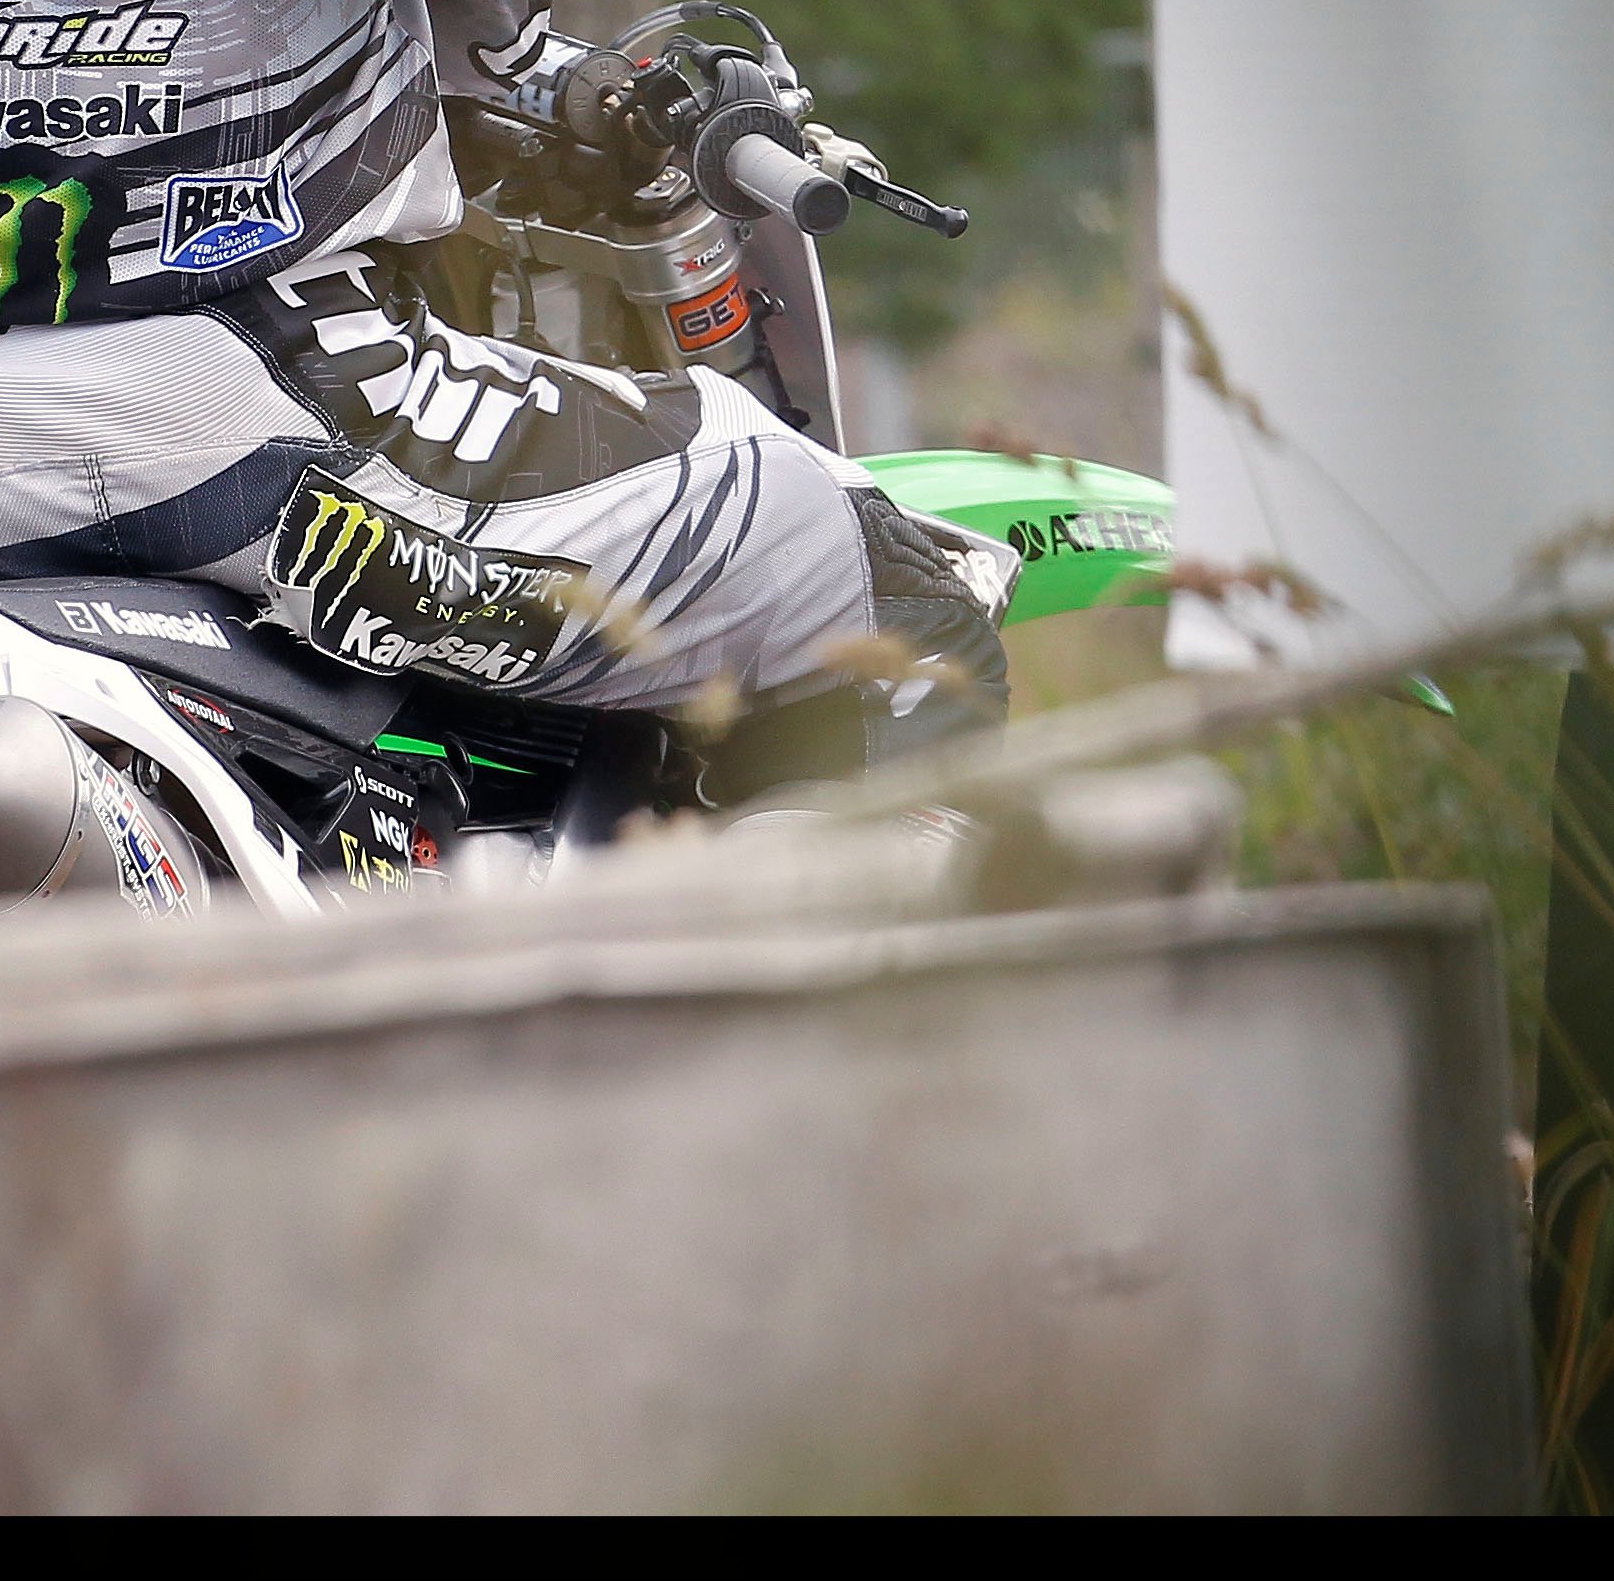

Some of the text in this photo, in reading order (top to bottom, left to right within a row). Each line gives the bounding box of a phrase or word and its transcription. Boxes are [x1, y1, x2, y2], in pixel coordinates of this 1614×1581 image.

[67, 52, 169, 64] RACING
[90, 601, 232, 650] Kawasaki
[415, 596, 519, 625] ENEGY
[339, 606, 538, 683] Kawsaki
[367, 777, 415, 808] SCOTT
